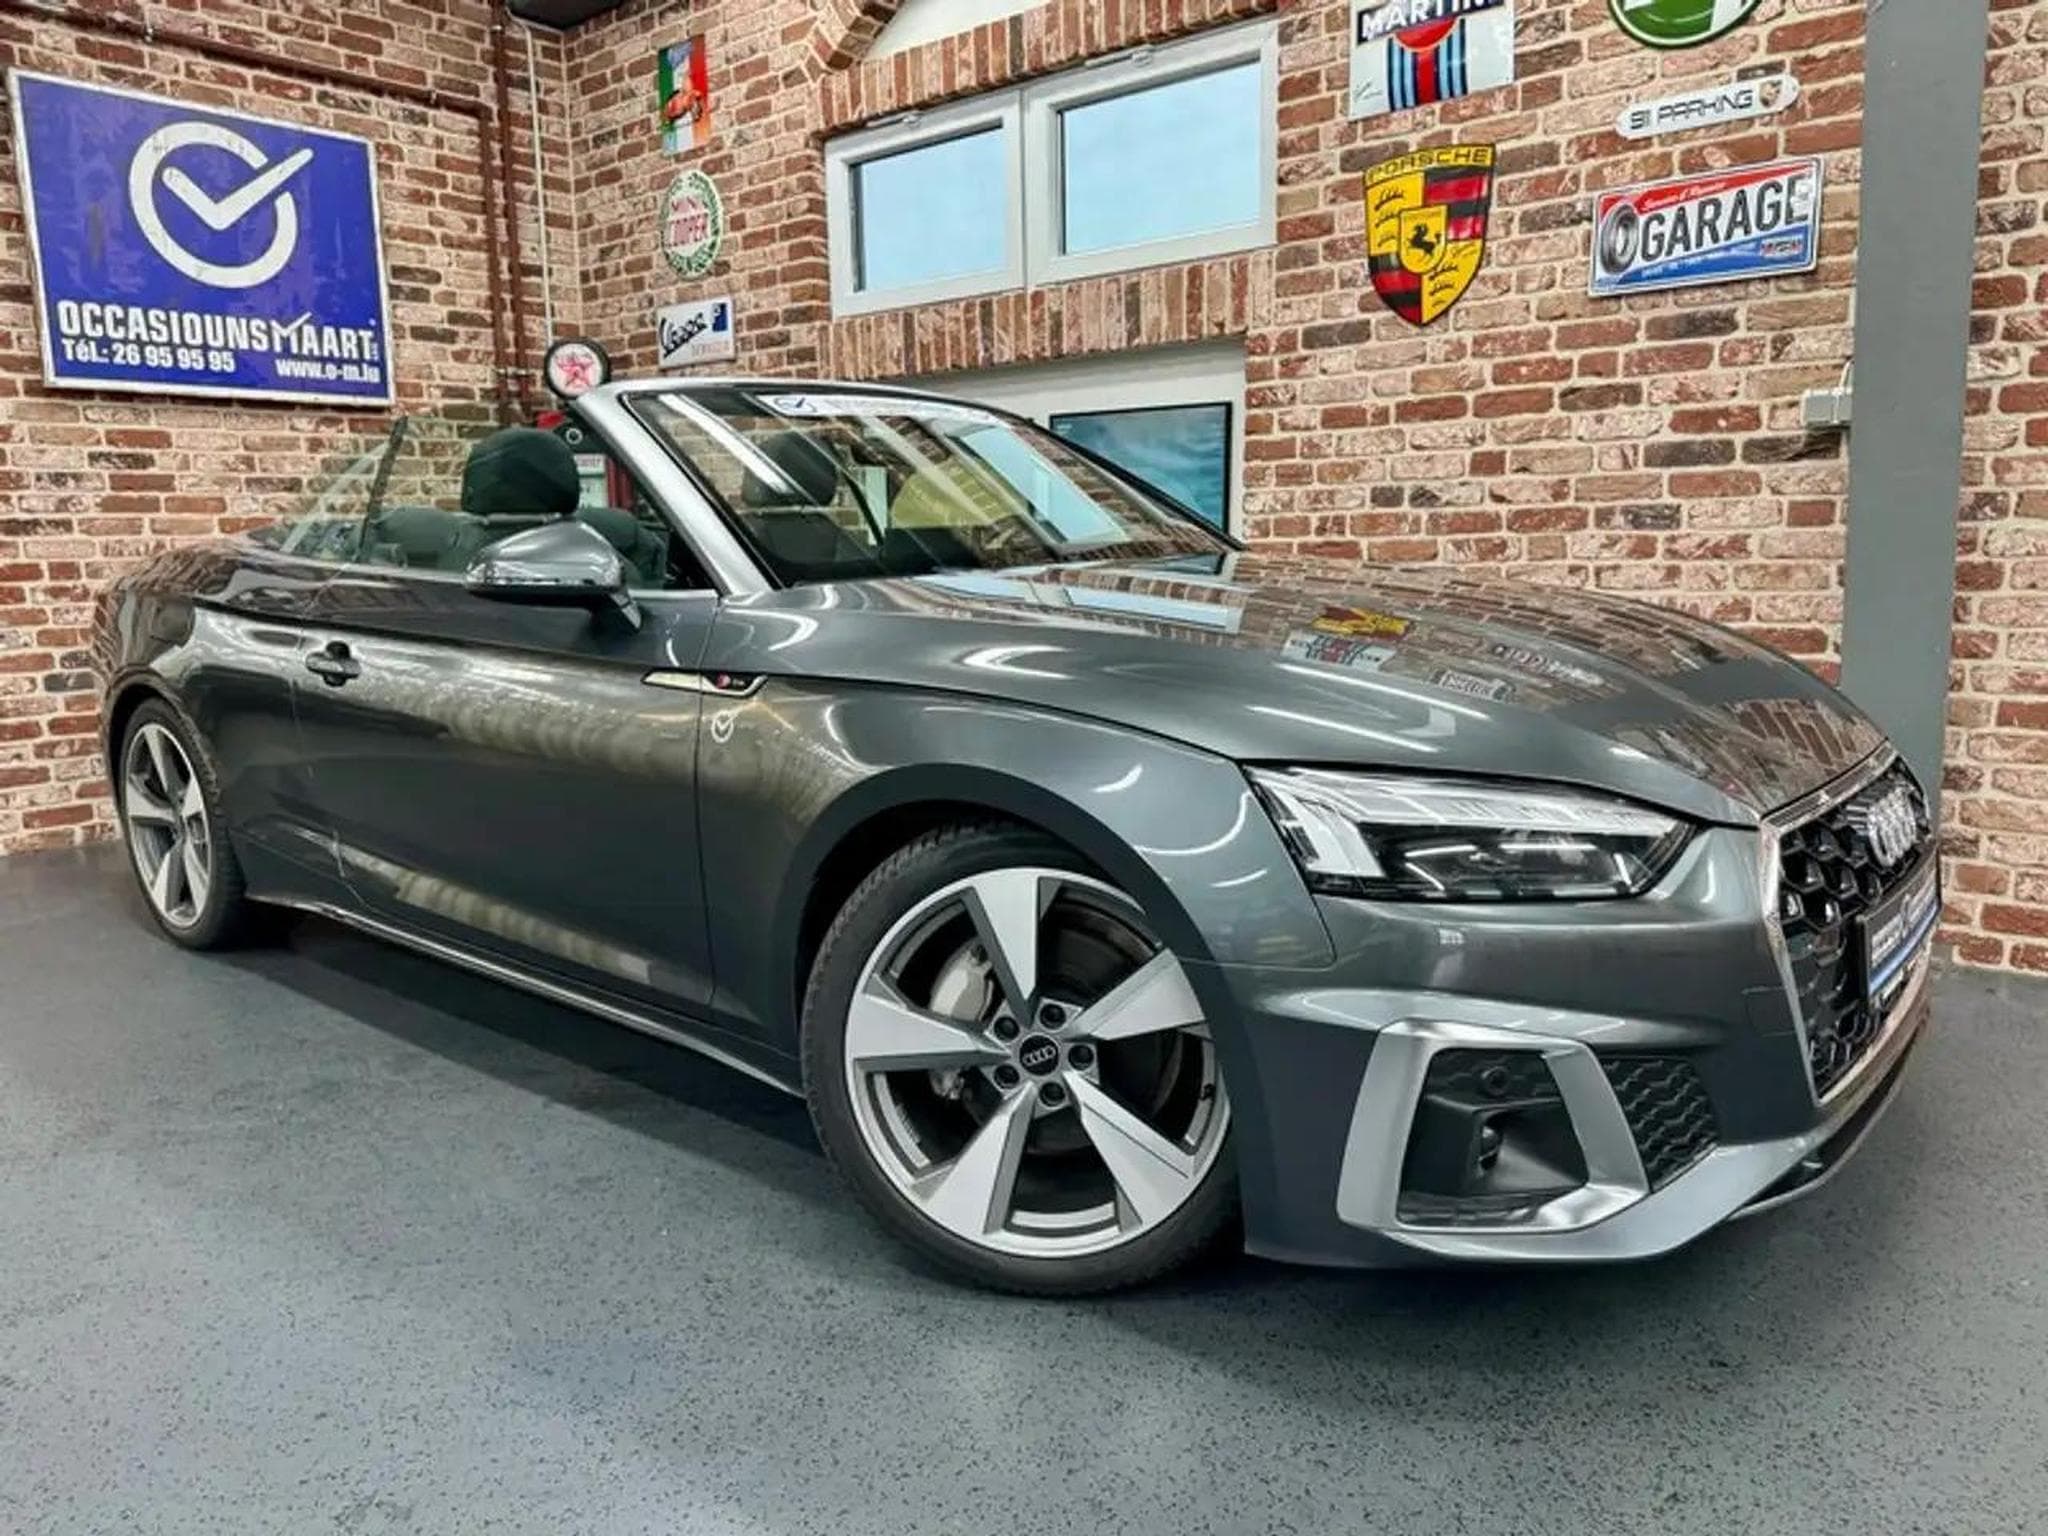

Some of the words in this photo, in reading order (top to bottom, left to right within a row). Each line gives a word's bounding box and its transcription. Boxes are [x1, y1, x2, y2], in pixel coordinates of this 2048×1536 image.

[1657, 89, 1753, 122] PARKING
[1368, 147, 1488, 184] PORSCHE
[1640, 172, 1813, 262] GARAGE
[112, 342, 140, 366] 26
[144, 345, 172, 368] 95
[176, 347, 205, 371] 95
[207, 350, 236, 373] 95
